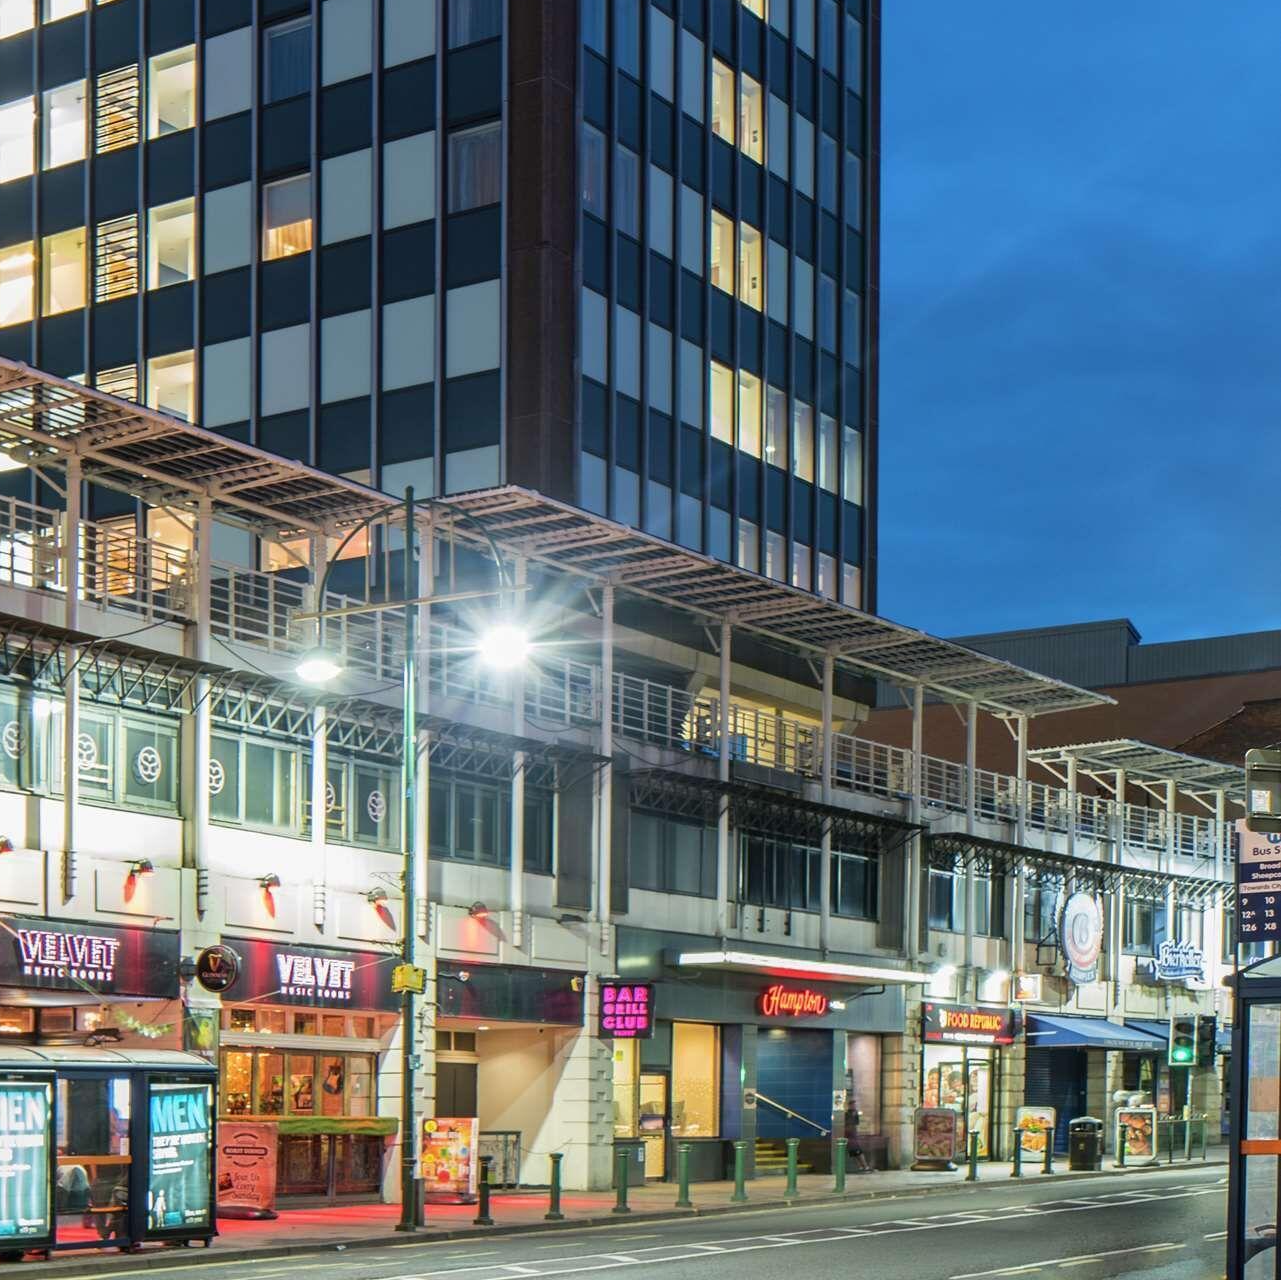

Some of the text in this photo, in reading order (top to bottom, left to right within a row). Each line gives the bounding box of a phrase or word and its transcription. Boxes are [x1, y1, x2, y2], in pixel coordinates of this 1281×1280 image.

[1252, 847, 1271, 856] Bus
[1241, 896, 1276, 907] 9 10
[1264, 909, 1275, 918] 13
[1241, 922, 1277, 933] 126 X8
[17, 929, 120, 970] VELVET
[24, 965, 113, 981] MUSIC ROOMS
[276, 953, 355, 989] VELVET
[280, 986, 351, 1000] MUSIC ROOMS
[603, 986, 648, 1002] BAR
[763, 985, 827, 1016] Hampton
[603, 1002, 648, 1015] GRILL
[603, 1016, 648, 1030] CLUB
[948, 1011, 1001, 1031] FOOD REPUBLIC
[151, 1093, 207, 1133] MEN
